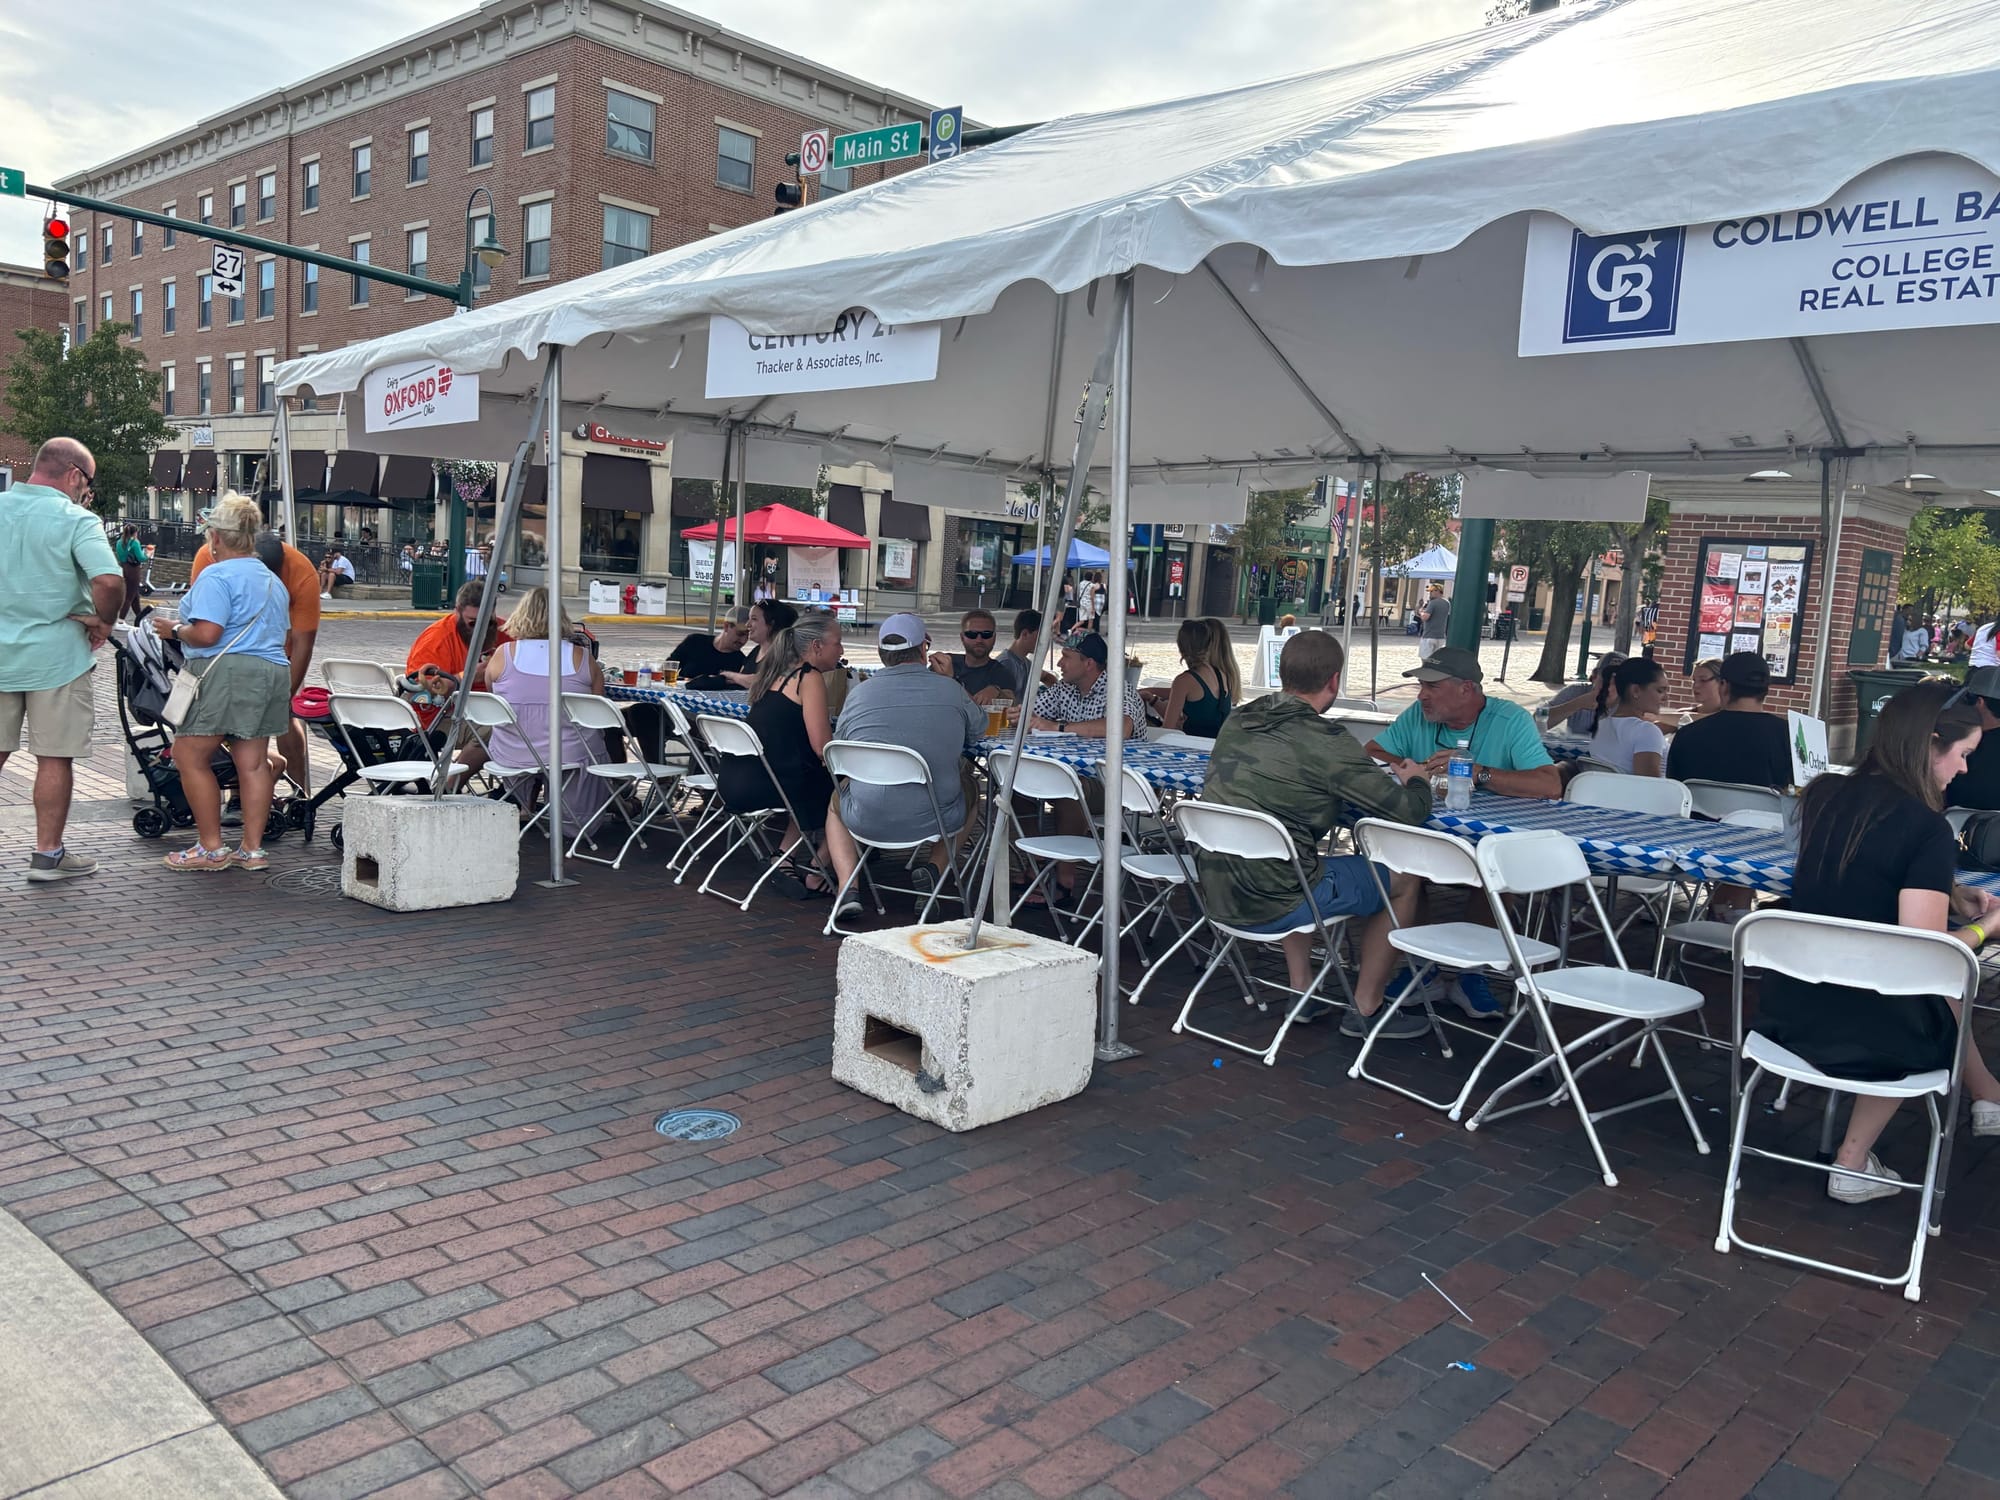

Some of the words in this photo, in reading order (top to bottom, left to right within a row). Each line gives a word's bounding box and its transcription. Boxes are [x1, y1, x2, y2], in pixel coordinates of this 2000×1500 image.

[844, 137, 882, 161] Main
[890, 130, 909, 153] St
[1713, 196, 1939, 249] COLDWELL
[216, 253, 240, 273] 27
[1831, 244, 1994, 281] COLLEGE
[1799, 283, 1885, 312] REAL
[756, 359, 794, 375] Thacker
[796, 357, 804, 371] &
[806, 353, 862, 371] Associates,
[865, 350, 883, 365] Inc.
[384, 377, 436, 417] OXFORD
